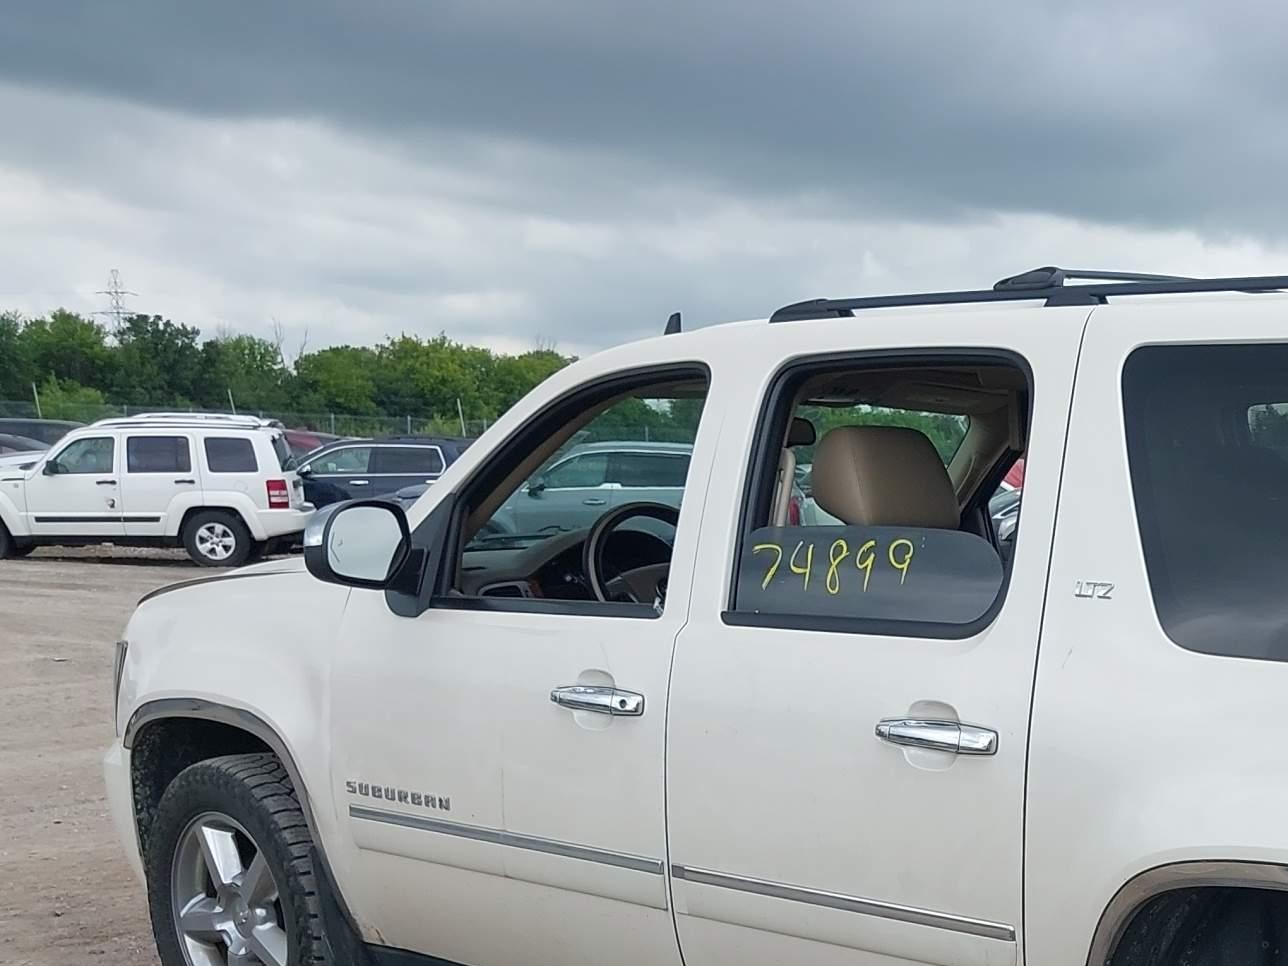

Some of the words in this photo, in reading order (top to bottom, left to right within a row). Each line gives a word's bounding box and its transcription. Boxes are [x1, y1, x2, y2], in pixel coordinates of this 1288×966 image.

[752, 539, 914, 594] 74899
[1074, 581, 1114, 600] LTZ
[346, 780, 451, 811] SUBURBAN
